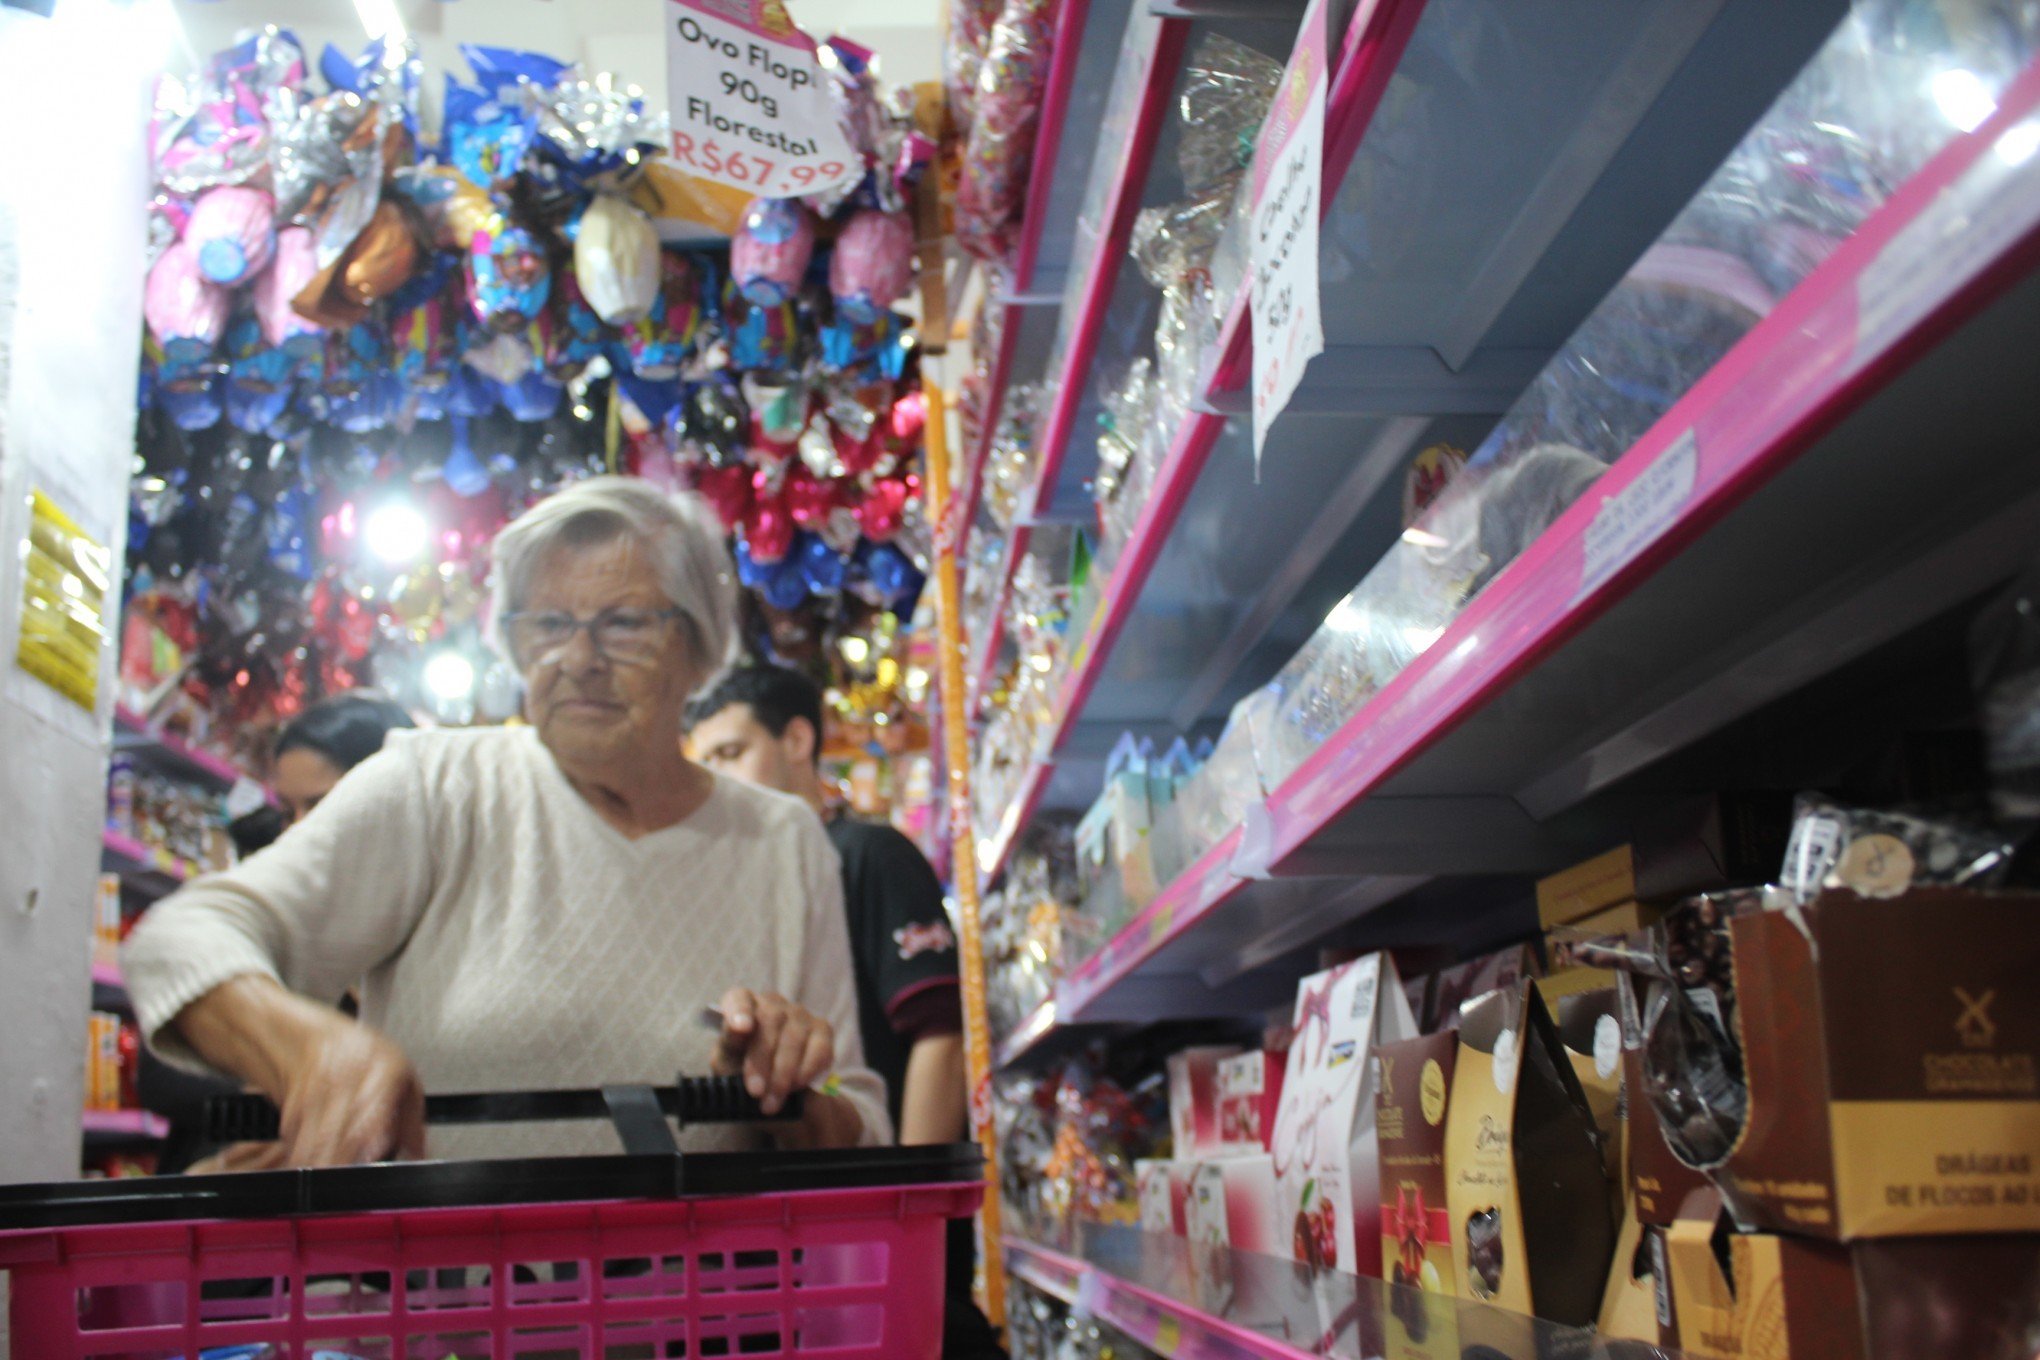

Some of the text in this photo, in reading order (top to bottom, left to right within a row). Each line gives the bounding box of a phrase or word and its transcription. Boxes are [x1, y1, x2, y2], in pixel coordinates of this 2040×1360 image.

[678, 17, 739, 58] Ovo
[720, 71, 778, 119] 90g
[687, 96, 819, 157] Florestal
